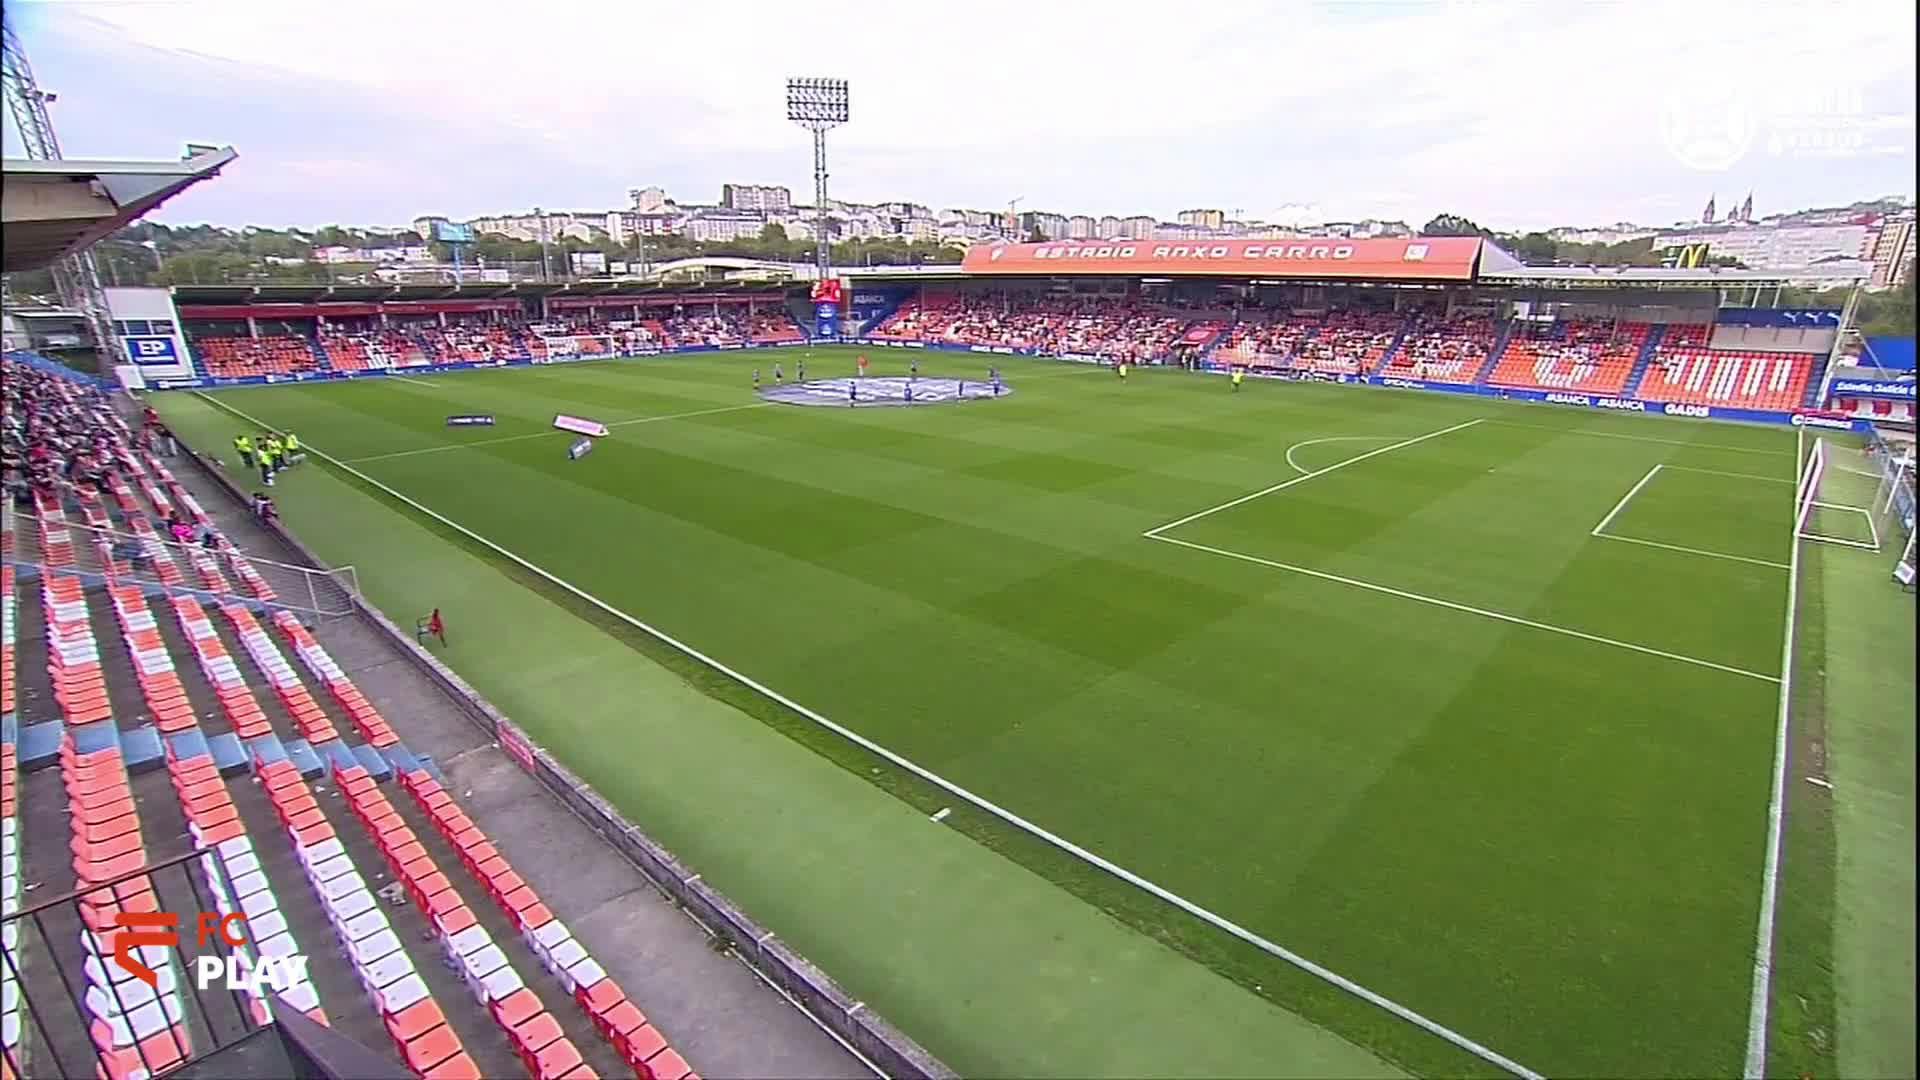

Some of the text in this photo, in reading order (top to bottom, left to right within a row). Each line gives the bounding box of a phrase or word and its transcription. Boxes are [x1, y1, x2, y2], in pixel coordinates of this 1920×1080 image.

[1033, 246, 1353, 259] ESTADIO ANXO CARRO
[137, 340, 166, 355] EP
[1545, 393, 1590, 406] ABANCA
[1597, 399, 1645, 412] ABANCA
[1664, 403, 1710, 417] GADIS
